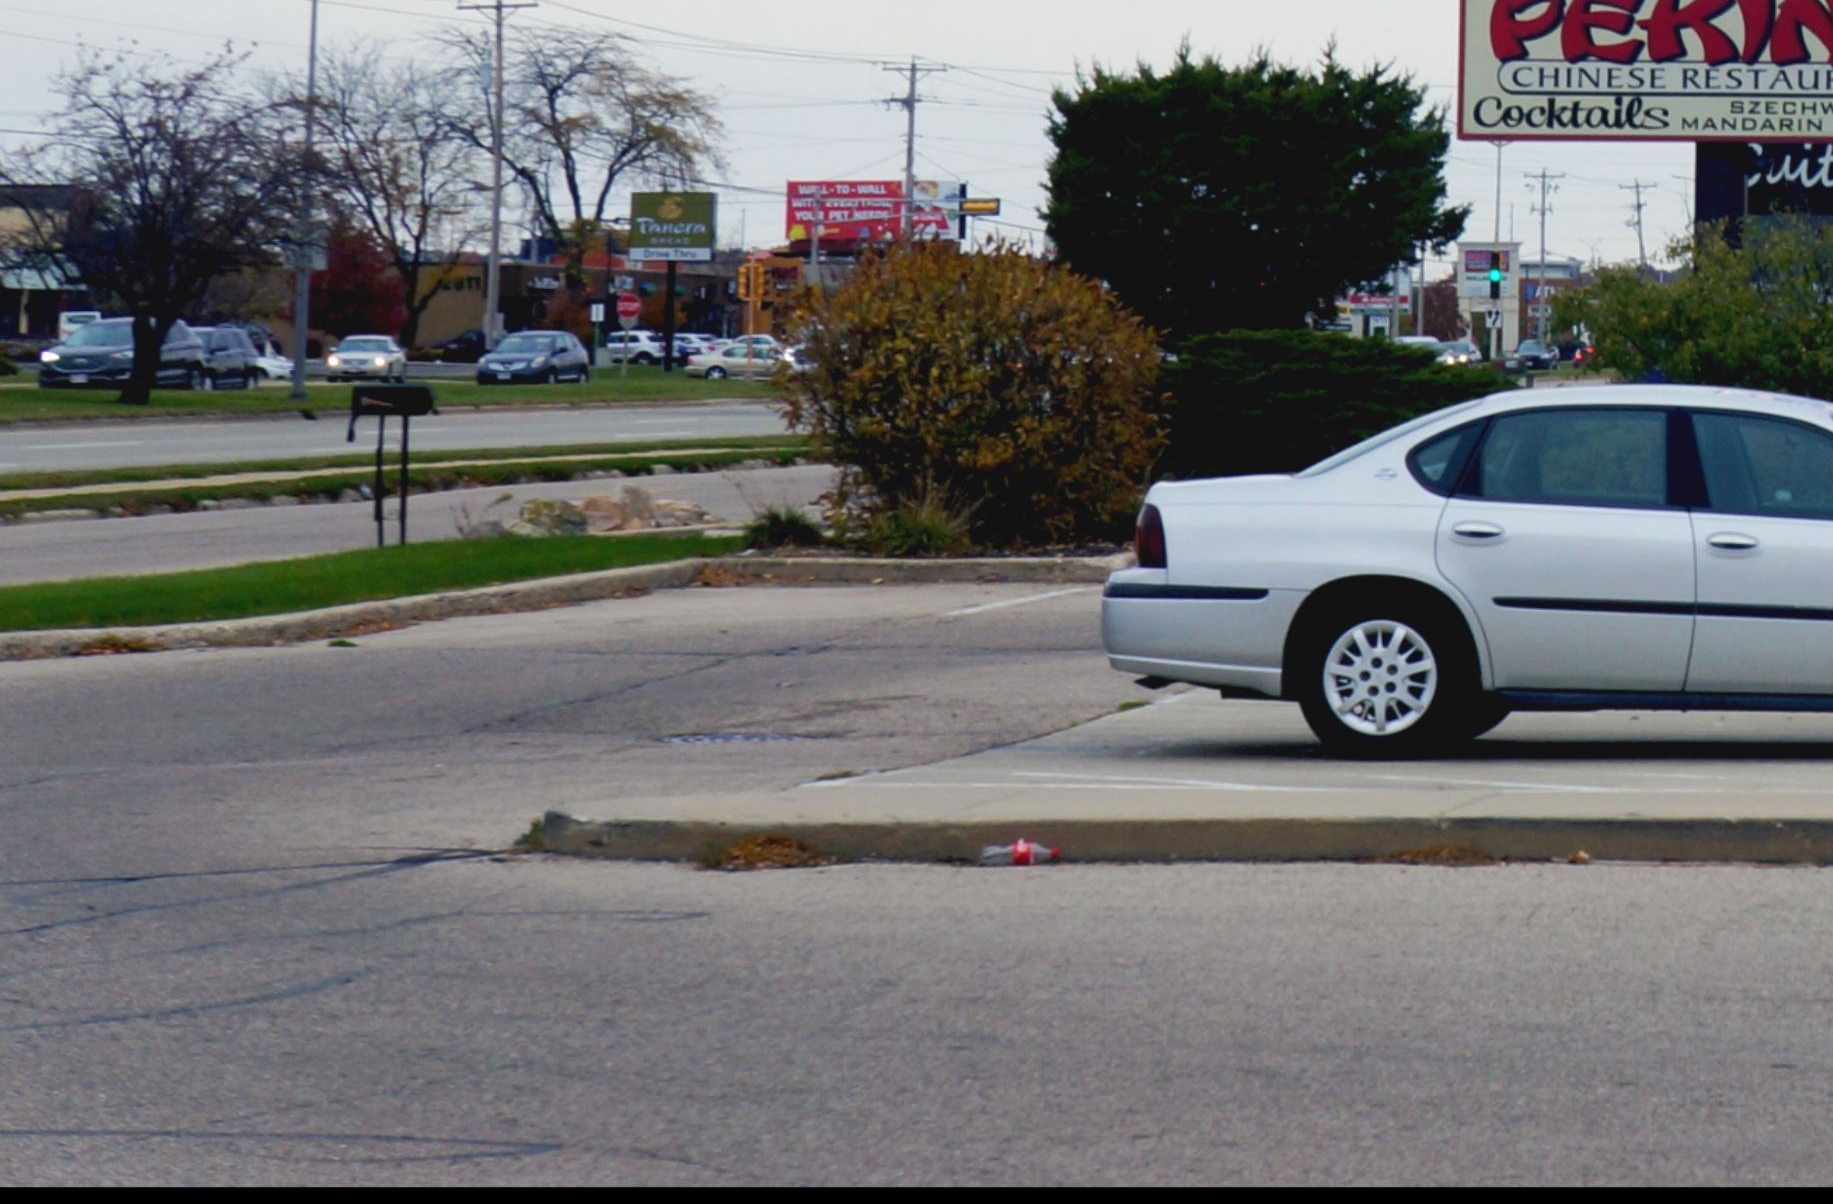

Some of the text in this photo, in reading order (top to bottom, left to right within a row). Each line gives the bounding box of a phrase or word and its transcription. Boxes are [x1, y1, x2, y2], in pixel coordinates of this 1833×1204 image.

[1512, 66, 1667, 90] CHINESE
[1472, 96, 1671, 130] Cocktails
[1681, 116, 1824, 133] MANDARIN
